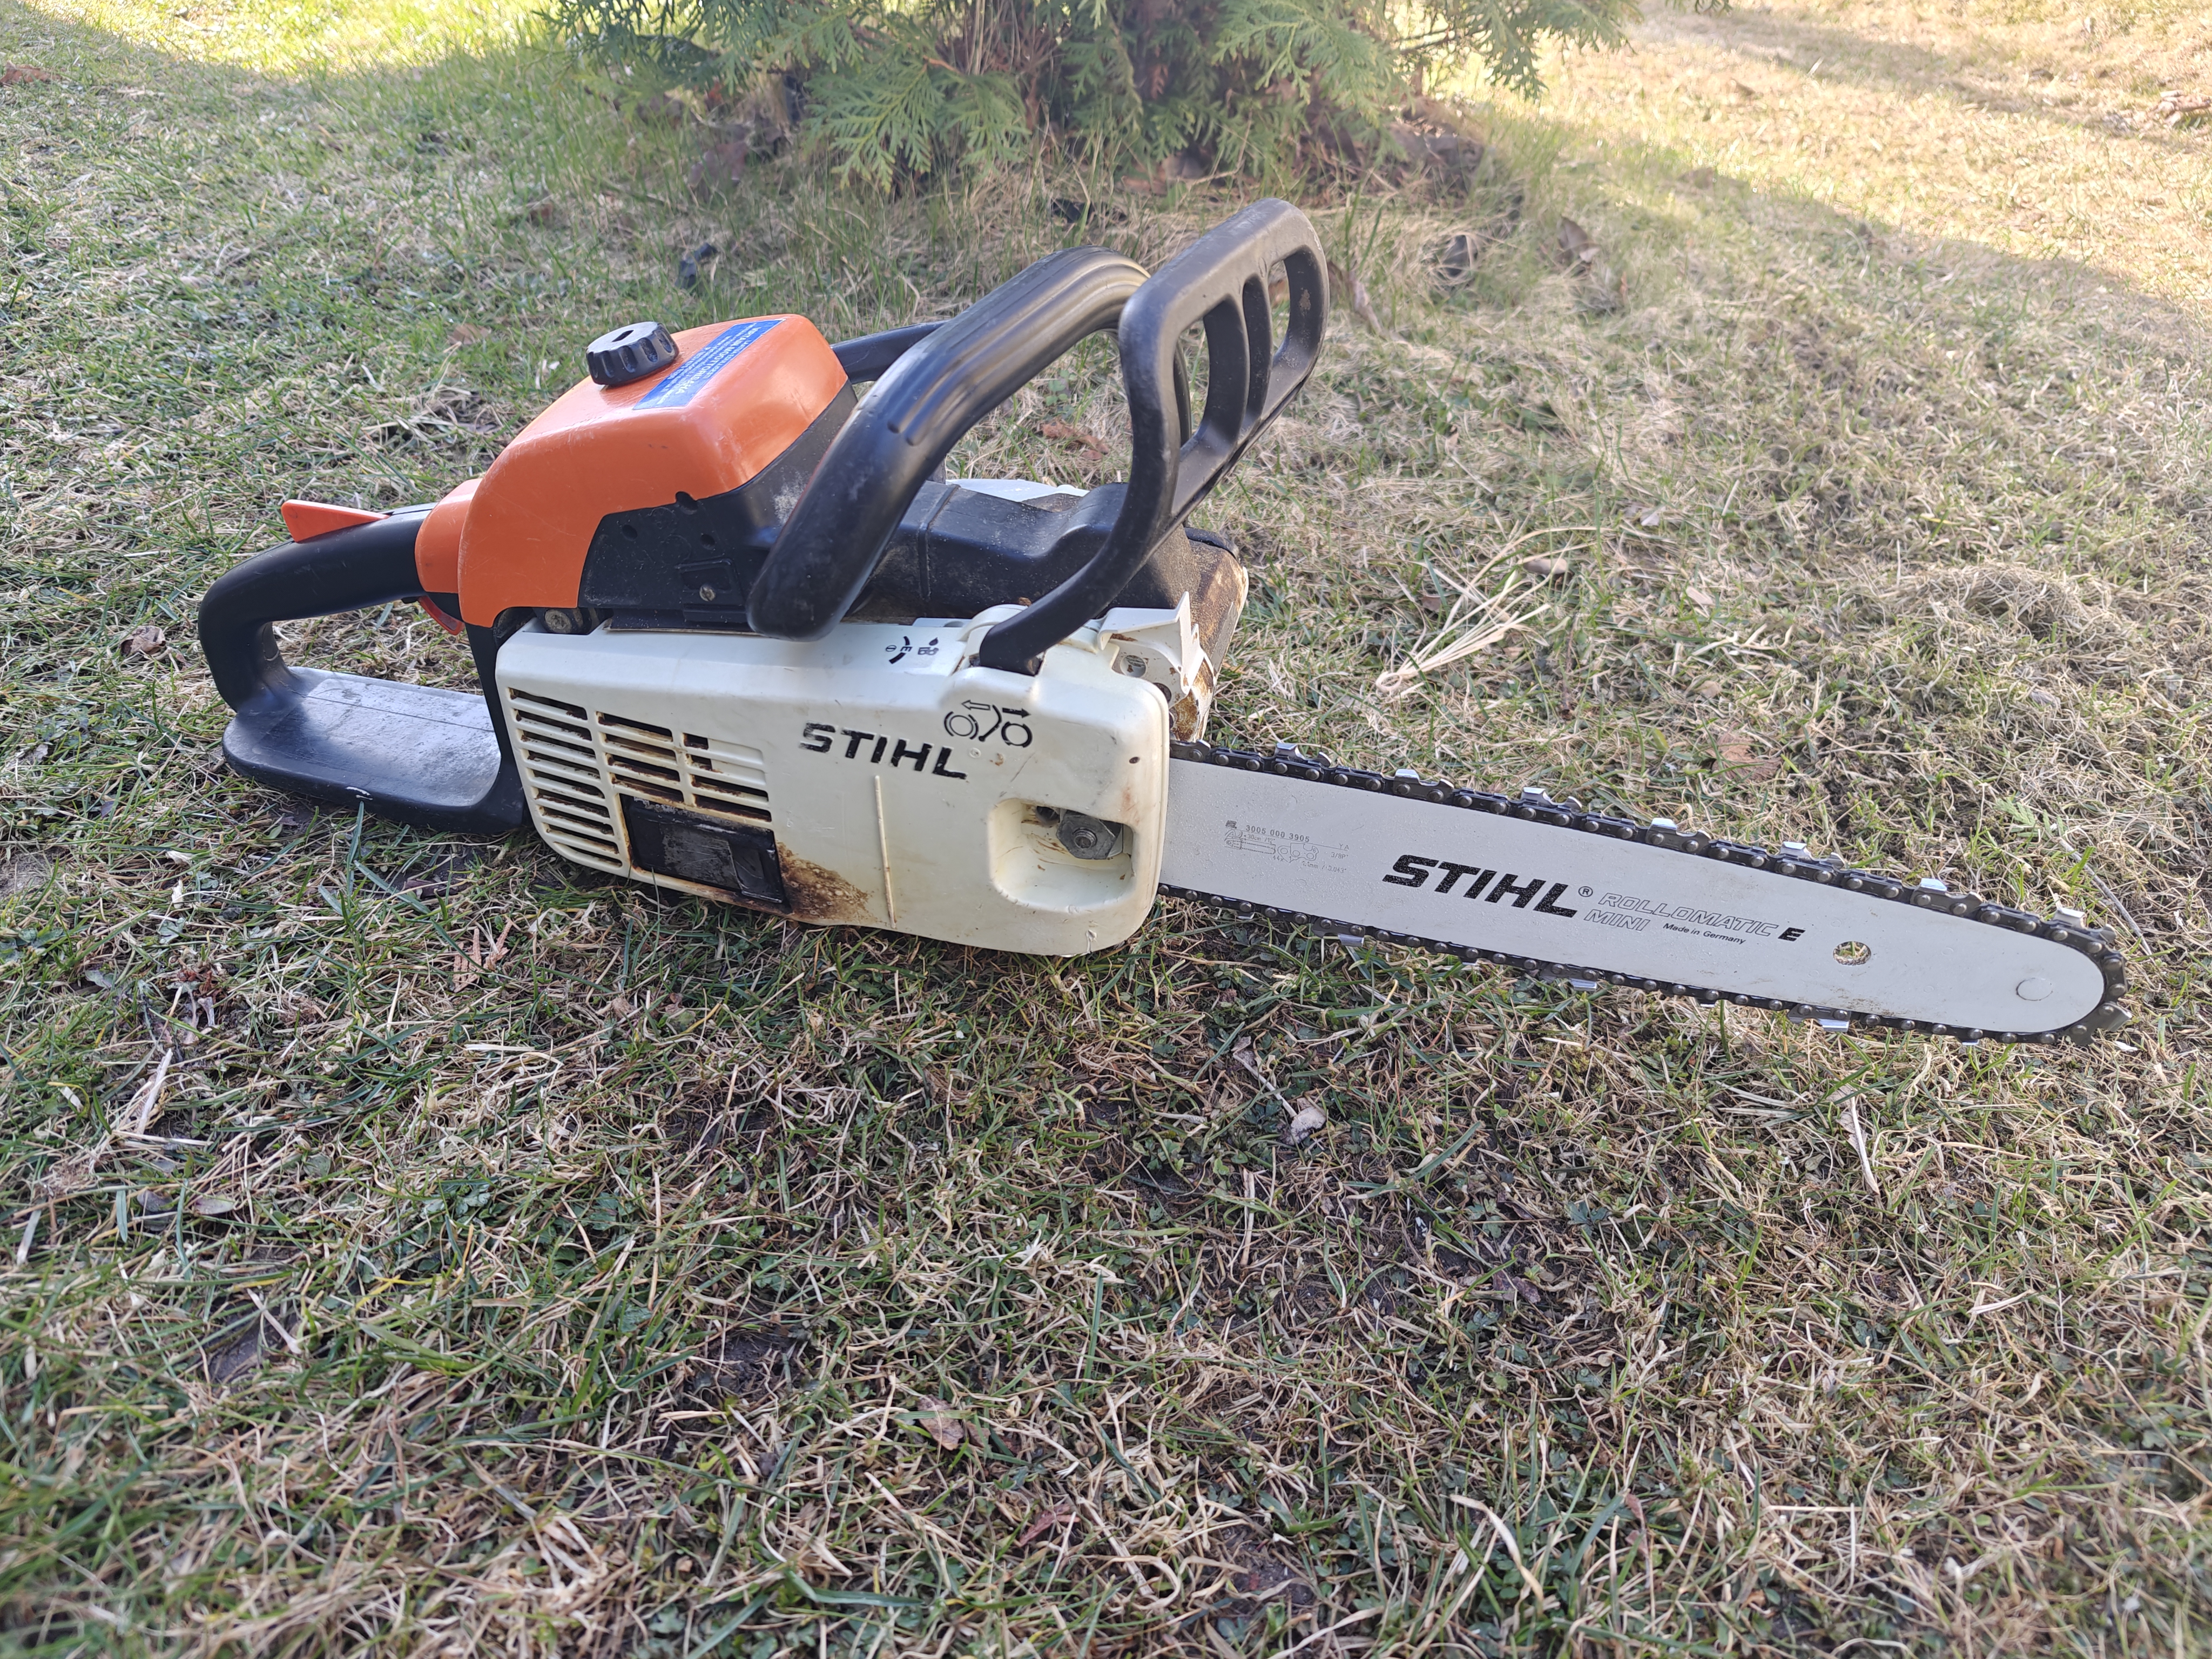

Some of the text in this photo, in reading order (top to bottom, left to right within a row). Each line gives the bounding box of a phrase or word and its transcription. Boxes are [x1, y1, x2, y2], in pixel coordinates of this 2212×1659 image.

[671, 346, 737, 394] MOOTTORISAHA
[799, 720, 968, 780] STIHL
[1245, 825, 1310, 842] 3005 000 3905
[1382, 854, 1577, 918] STIHL
[1584, 909, 1651, 932] MINI
[1598, 893, 1805, 942] ROLLOMATIC E
[1663, 922, 1746, 945] Made in Germany
